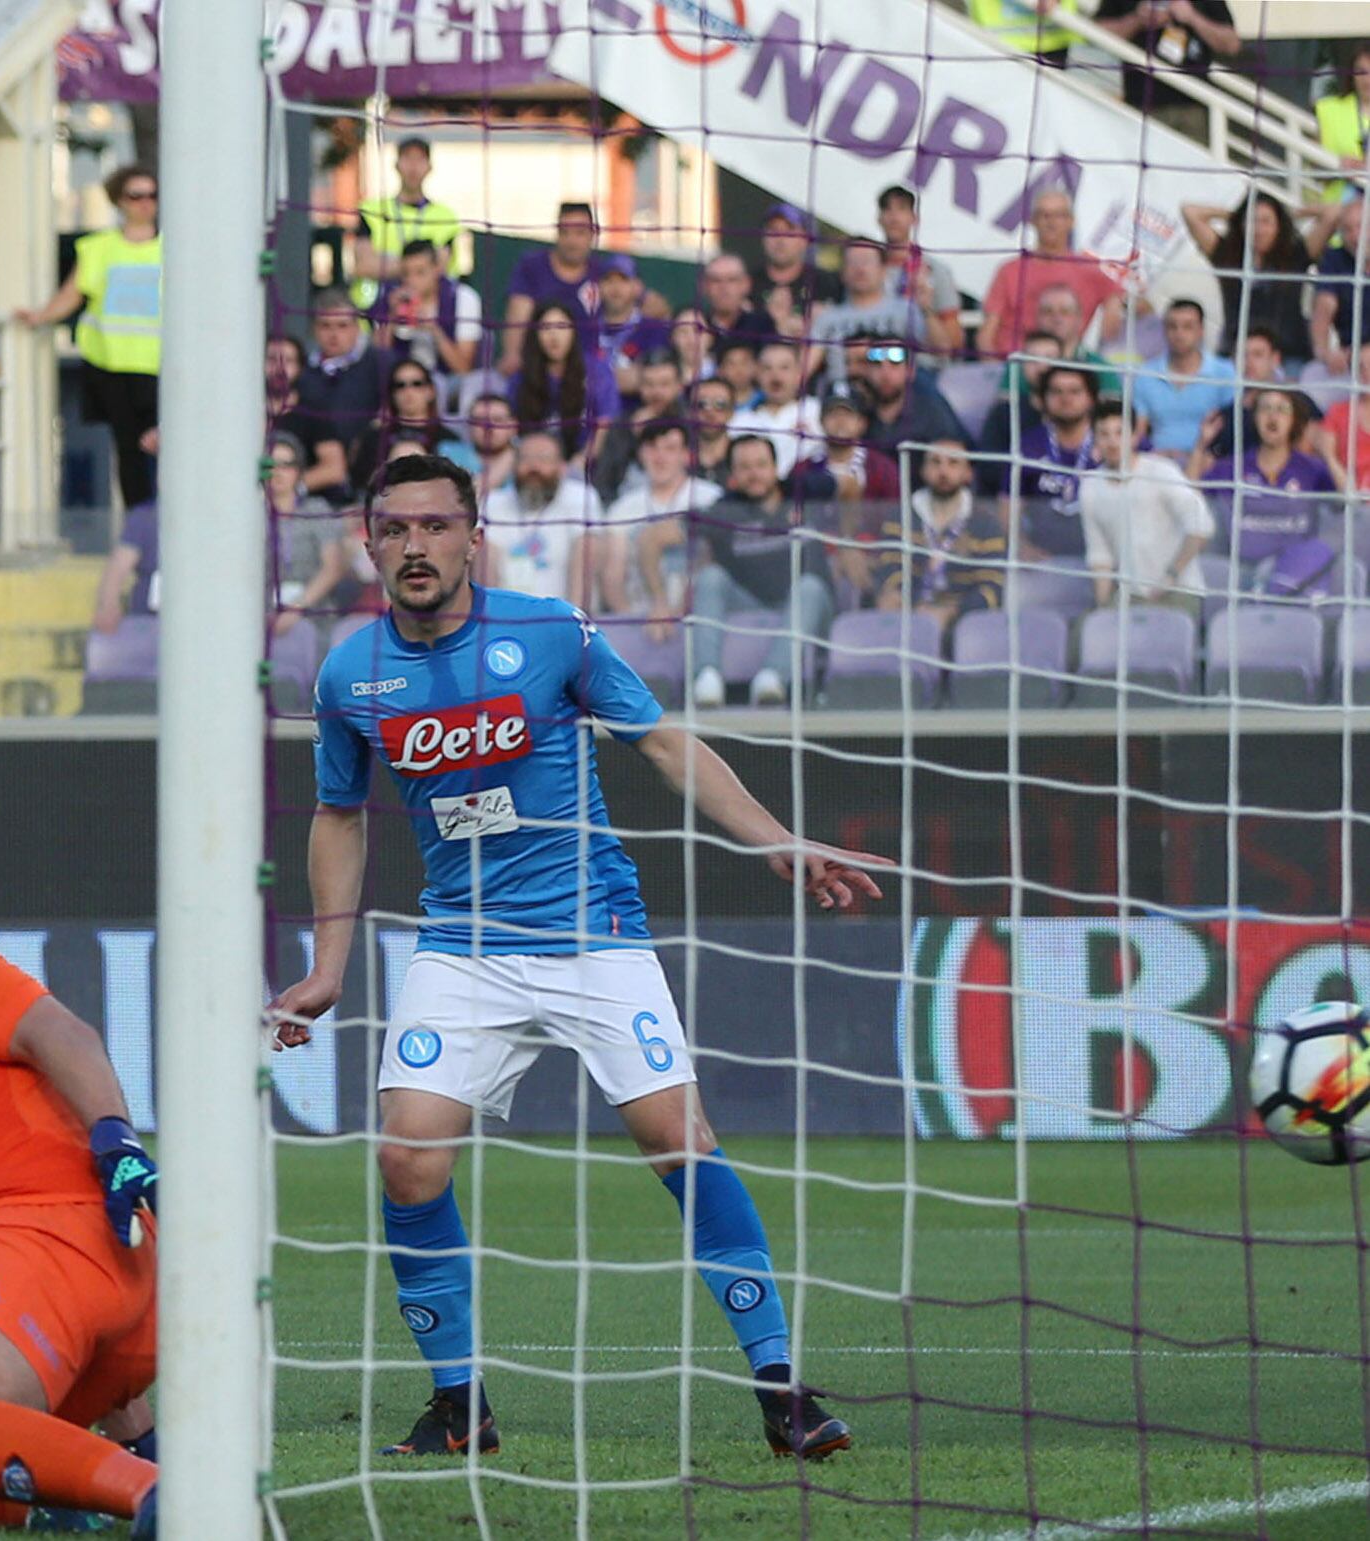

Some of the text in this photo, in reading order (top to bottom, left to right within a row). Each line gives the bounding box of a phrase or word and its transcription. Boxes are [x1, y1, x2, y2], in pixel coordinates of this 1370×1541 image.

[493, 646, 516, 670] N
[351, 677, 408, 697] Kappa
[390, 711, 526, 771] Lete
[410, 1036, 429, 1056] N
[632, 1010, 673, 1073] 6
